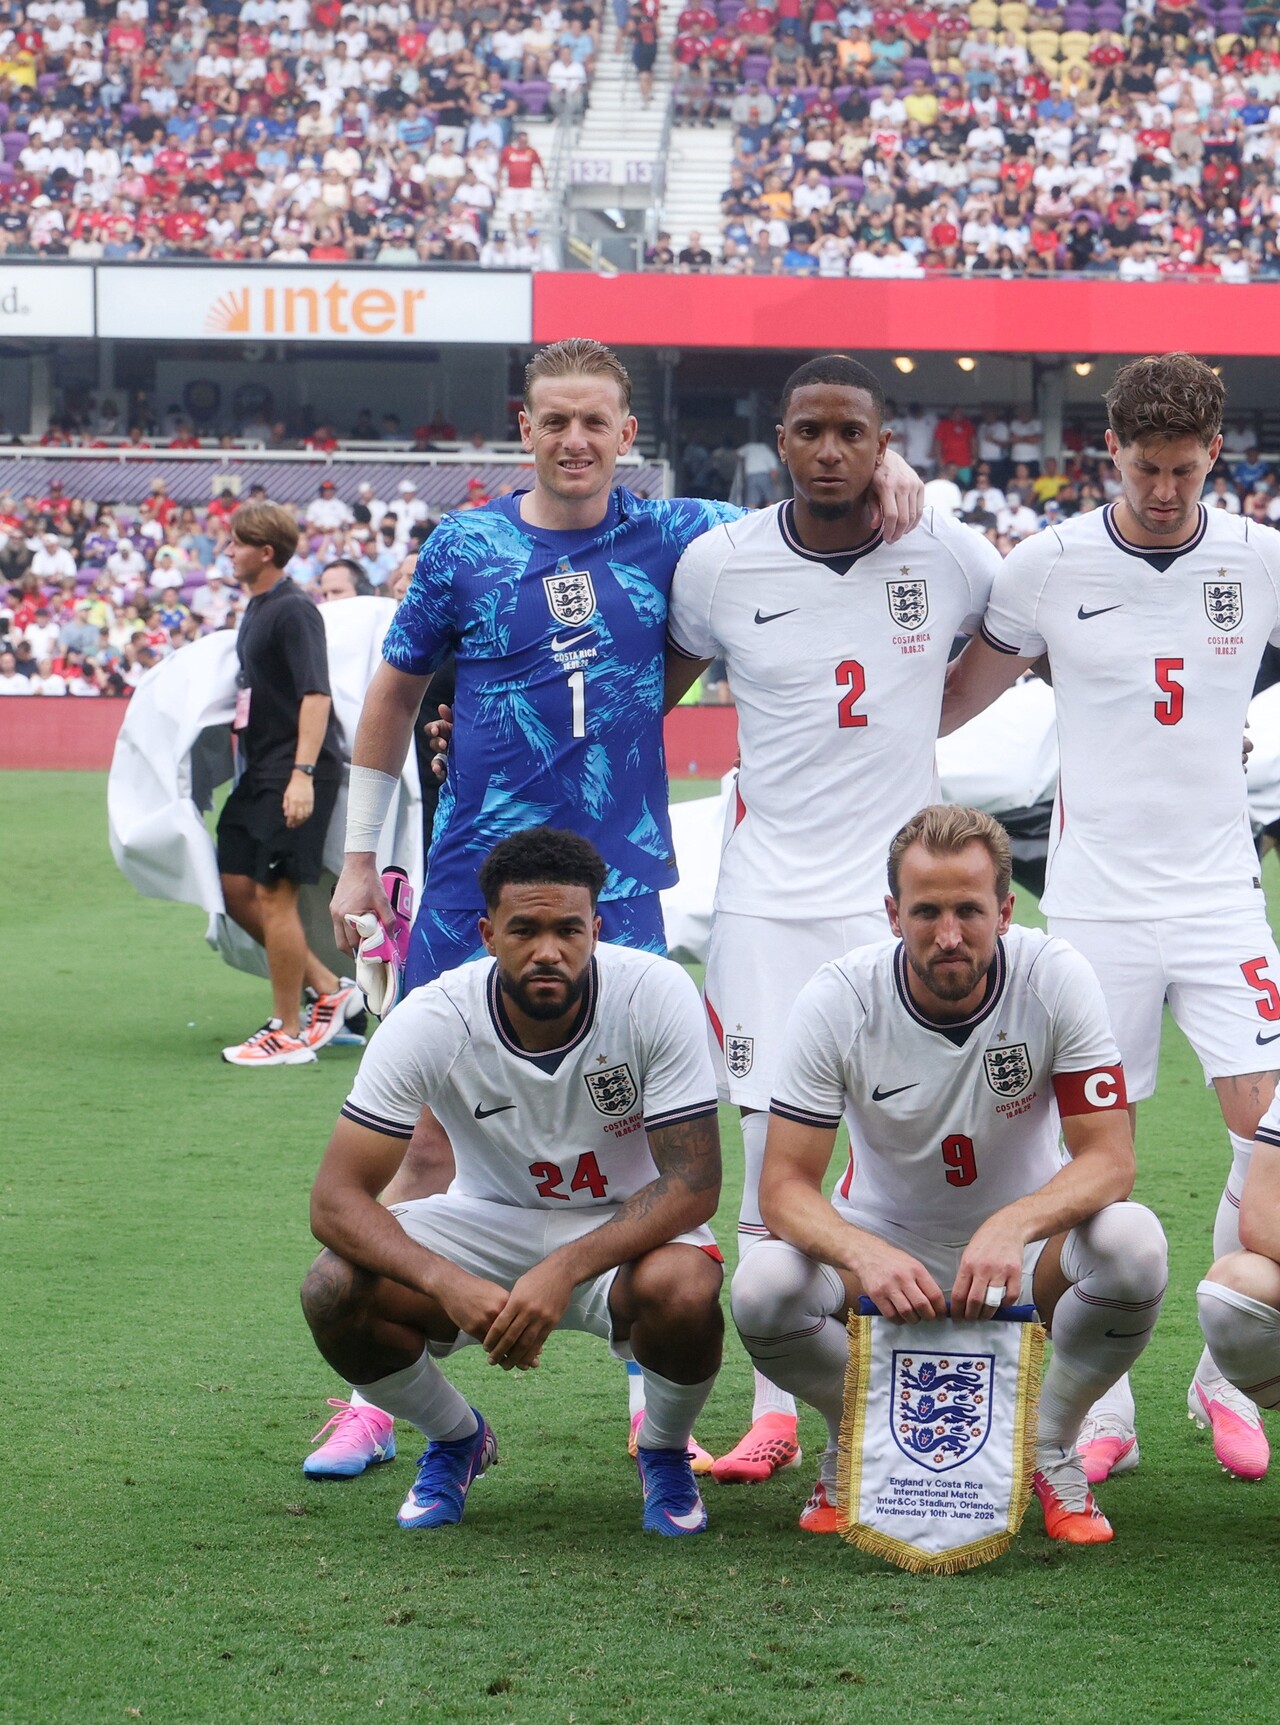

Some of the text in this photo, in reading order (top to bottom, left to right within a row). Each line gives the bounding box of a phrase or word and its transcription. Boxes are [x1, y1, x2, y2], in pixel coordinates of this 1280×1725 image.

[264, 278, 426, 335] inter
[892, 633, 931, 645] COSTA RICA
[1207, 636, 1244, 645] COSTA RICA
[554, 647, 598, 663] COSTA RICA
[901, 644, 925, 655] 10.06.26
[834, 659, 868, 729] 2
[1154, 657, 1185, 726] 5
[567, 670, 586, 738] 1
[1083, 1071, 1118, 1107] C
[995, 1091, 1037, 1113] COSTA RICA
[603, 1119, 629, 1133] COSTA
[940, 1133, 978, 1188] 9
[528, 1150, 609, 1201] 24
[889, 1477, 924, 1488] England
[934, 1479, 962, 1490] Costa
[964, 1480, 983, 1490] Rica
[893, 1487, 979, 1500] International Match
[877, 1496, 994, 1511] Inter&Co Stadium, Orlando
[875, 1506, 995, 1520] Wednesday 10th June 2026
